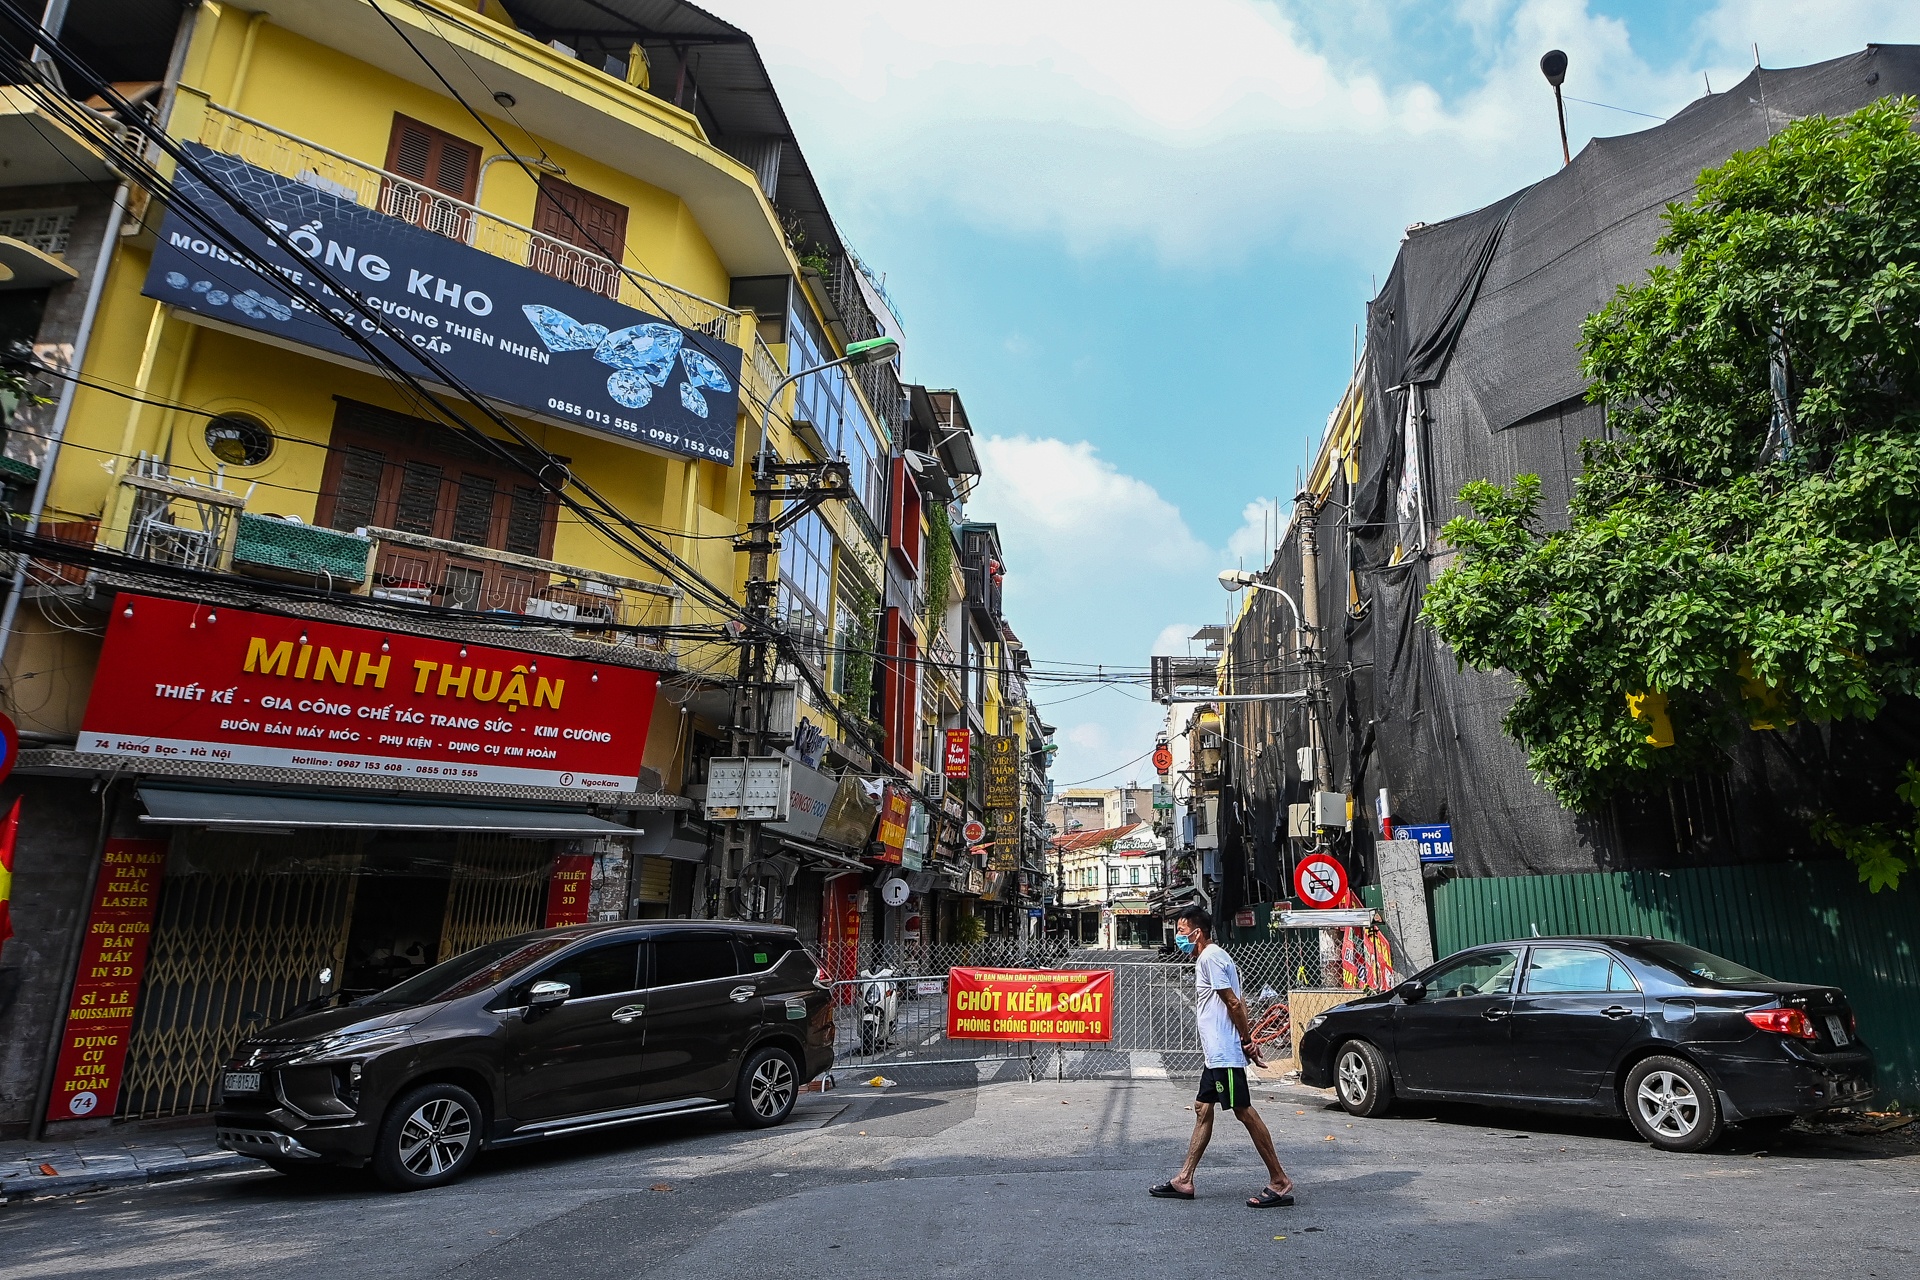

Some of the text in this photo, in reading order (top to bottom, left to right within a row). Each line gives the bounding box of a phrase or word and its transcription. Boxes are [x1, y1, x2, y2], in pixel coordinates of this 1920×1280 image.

[264, 217, 493, 317] TỔNG KHO
[169, 232, 303, 286] MOISSAITE
[366, 296, 439, 328] CƯƠNG
[445, 320, 495, 347] THIÊN
[499, 339, 550, 365] NHIÊN
[411, 334, 452, 355] CẤP
[547, 397, 582, 416] 0855
[585, 409, 610, 425] 013
[614, 418, 638, 433] 555
[649, 428, 679, 445] 0987
[684, 438, 705, 452] 153
[708, 446, 730, 460] 608
[243, 636, 565, 713] MINH THUẬN
[154, 682, 205, 701] THIẾT
[210, 686, 238, 705] KẾ
[260, 695, 293, 711] GIA
[298, 698, 352, 717] CÔNG
[357, 703, 394, 721] CHẾ
[395, 707, 425, 724] TÁC
[430, 713, 480, 731] TRANG
[483, 717, 513, 733] SỨC
[533, 725, 559, 738] KIM
[562, 727, 612, 743] CƯƠNG
[219, 719, 260, 733] BUÔN
[263, 721, 292, 736] BÁN
[295, 724, 325, 739] MÁY
[328, 727, 361, 742] MÓC
[378, 734, 403, 748] PHỤ
[406, 735, 433, 750] KIỆN
[448, 740, 480, 754] DỤNG
[484, 743, 501, 755] CỤ
[503, 746, 524, 757] KIM
[526, 746, 557, 759] HOÀN
[94, 739, 110, 749] 74
[116, 740, 150, 754] Hàng
[155, 744, 178, 757] Bạc
[190, 745, 207, 757] Hà
[211, 749, 232, 761] Nội
[291, 755, 333, 767] Hotline:
[336, 759, 361, 769] 0987
[364, 761, 381, 770] 153
[383, 763, 403, 772] 608
[415, 765, 439, 775] 0855
[442, 767, 459, 776] 013
[461, 768, 479, 777] 555
[580, 777, 620, 788] NgocKara
[811, 800, 827, 818] FOOD
[1421, 829, 1442, 839] PHỐ
[996, 837, 1019, 845] CLINIC
[104, 850, 165, 863] BÁN MÁY
[115, 866, 148, 878] HÀN
[107, 879, 150, 893] KHẮC
[563, 882, 578, 893] KẾ
[101, 897, 148, 907] LASER
[562, 896, 576, 905] 3D
[91, 921, 150, 934] SỬA CHỮA
[555, 920, 577, 928] HÀ
[102, 935, 135, 948] BÁN
[98, 950, 133, 963] MÁY
[90, 966, 133, 978] IN 3D
[983, 973, 996, 981] BAN
[996, 973, 1013, 981] NHÂN
[1014, 973, 1027, 981] DÂN
[1052, 973, 1069, 982] HÀNG
[80, 991, 97, 1005] SỈ
[109, 990, 130, 1004] LẺ
[956, 984, 1104, 1013] CHỐT KIỂM SOÁT
[69, 1006, 134, 1020] MOISSANITE
[956, 1015, 1102, 1036] PHÒNG CHỐNG DỊCH COVID-19
[73, 1035, 118, 1049] DỤNG
[82, 1050, 105, 1063] CỤ
[73, 1064, 106, 1077] KIM
[64, 1076, 110, 1092] HOÀN
[73, 1097, 93, 1109] 74
